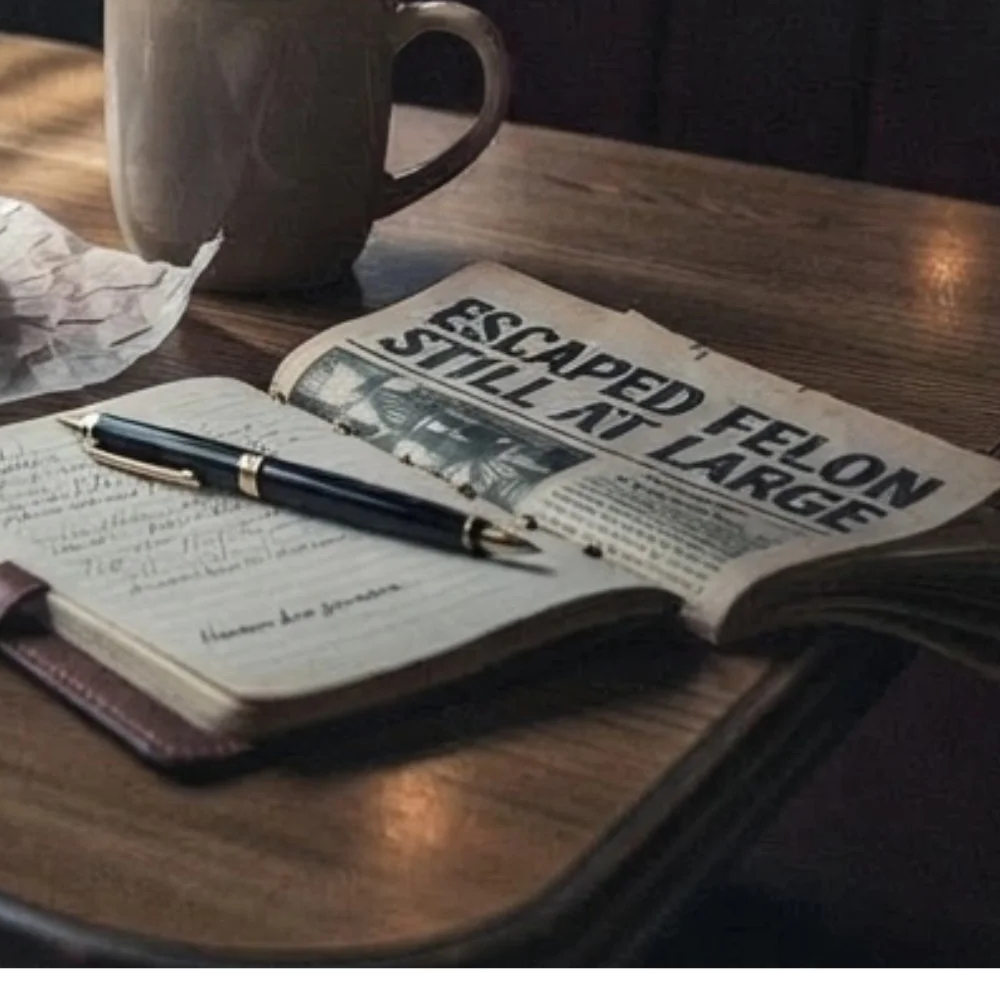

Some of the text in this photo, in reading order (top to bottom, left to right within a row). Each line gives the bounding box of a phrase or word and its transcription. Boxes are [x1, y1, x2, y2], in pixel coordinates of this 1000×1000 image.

[377, 326, 888, 533] STILL AT LARGE
[428, 297, 945, 509] ESCAPED FELON
